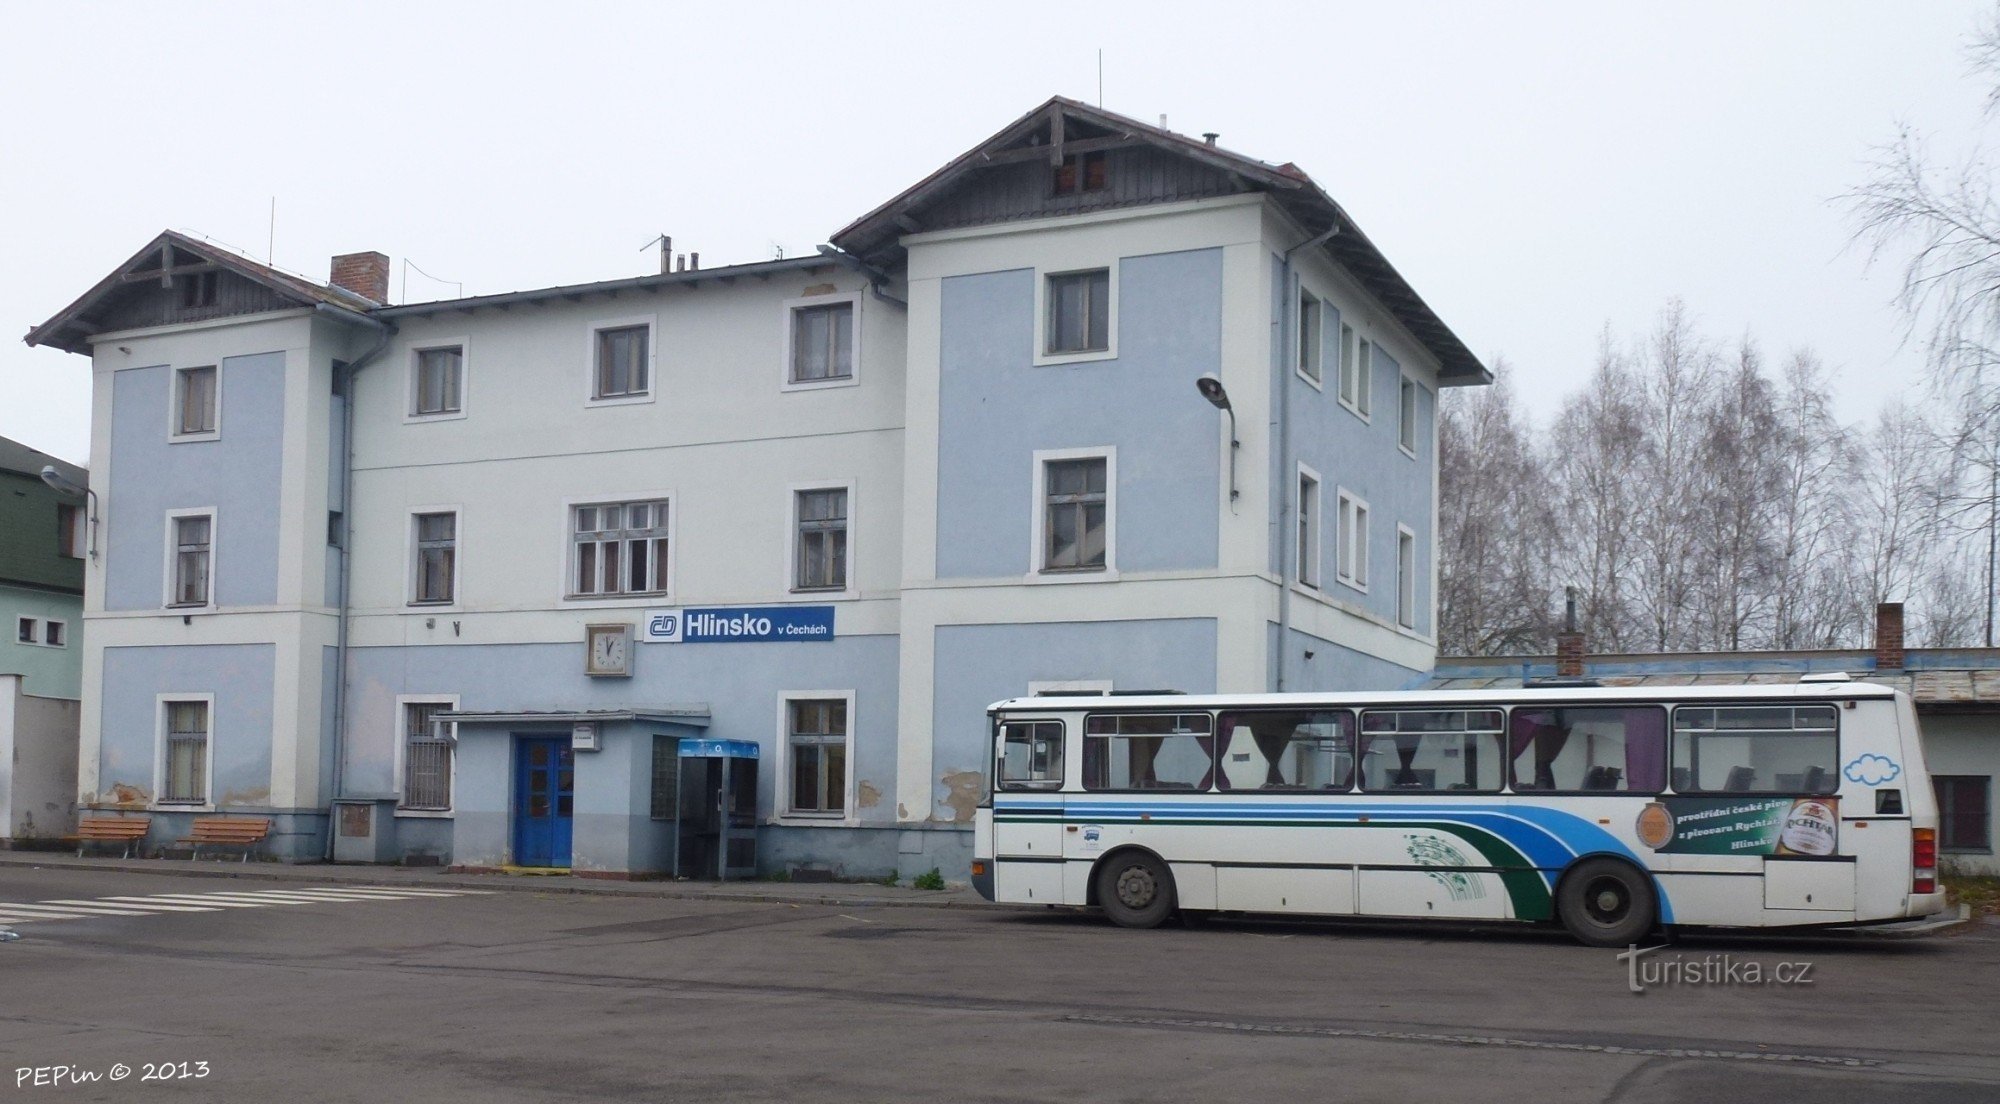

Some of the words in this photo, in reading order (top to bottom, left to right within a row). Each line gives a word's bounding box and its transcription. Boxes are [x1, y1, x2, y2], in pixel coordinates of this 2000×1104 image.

[687, 613, 771, 636] Hlinsko
[777, 626, 784, 635] v
[786, 623, 827, 635] Čechách
[1676, 807, 1731, 825] prvotřídní
[1732, 803, 1762, 815] české
[1764, 799, 1788, 811] pivo
[1687, 825, 1733, 840] pivovaru
[1731, 837, 1773, 850] Hlinsko
